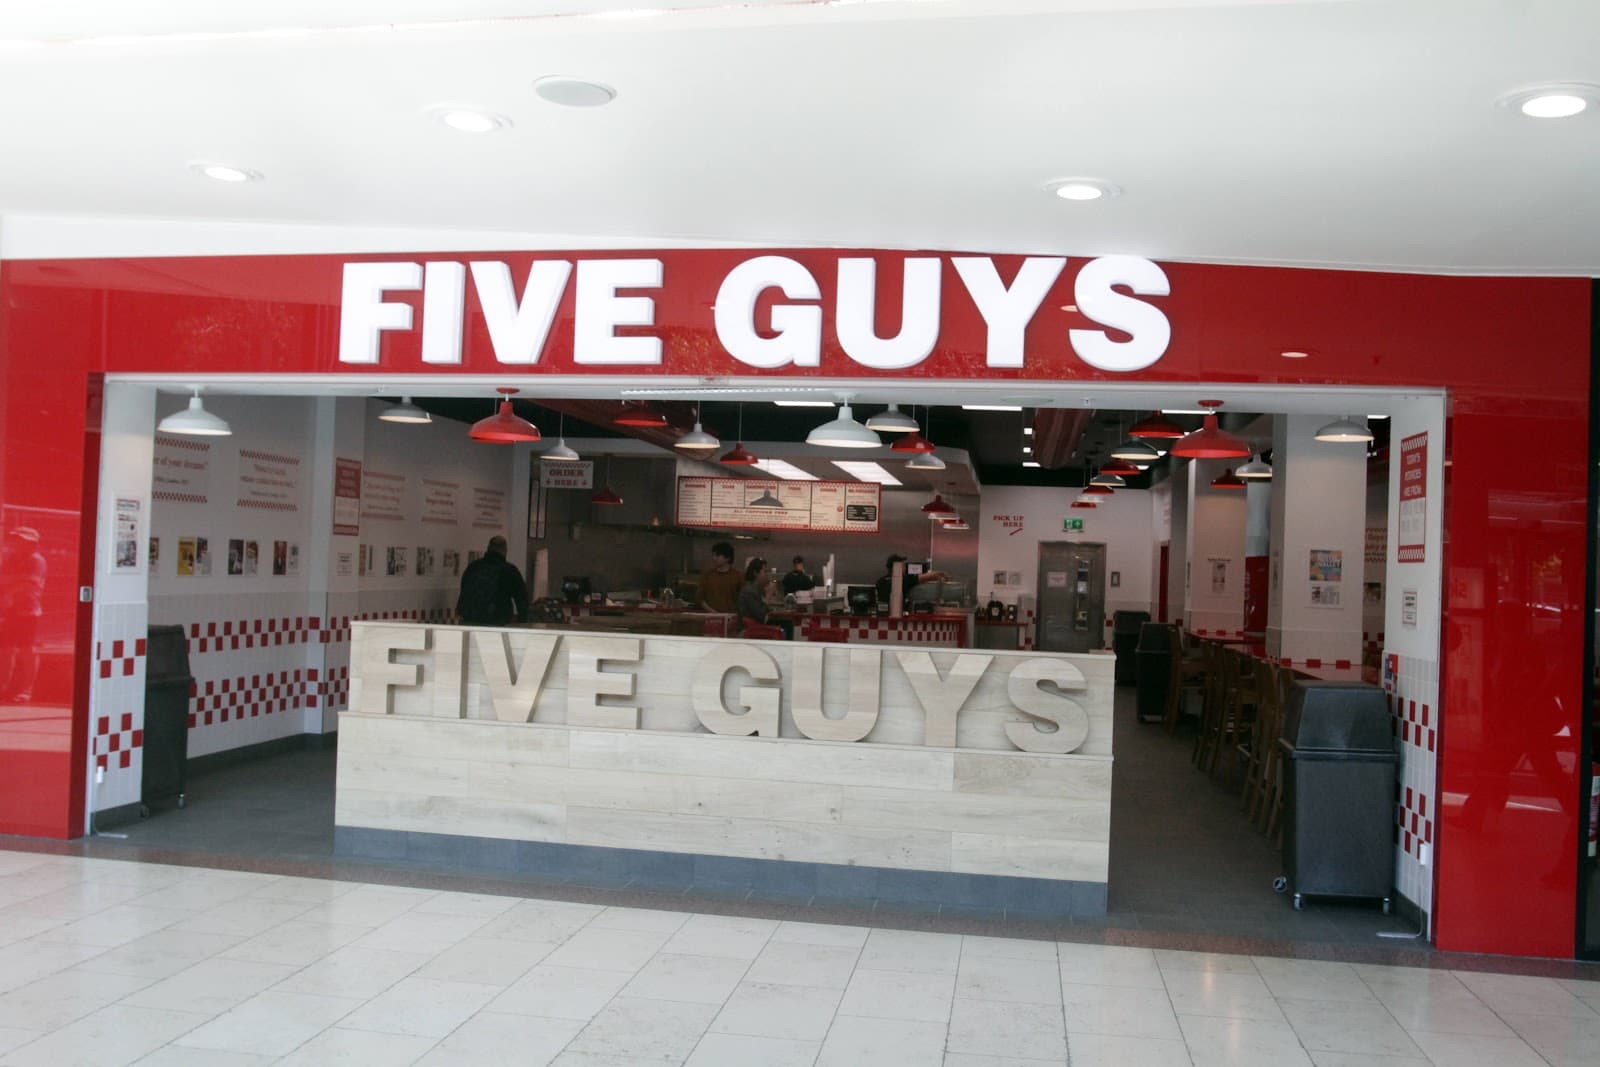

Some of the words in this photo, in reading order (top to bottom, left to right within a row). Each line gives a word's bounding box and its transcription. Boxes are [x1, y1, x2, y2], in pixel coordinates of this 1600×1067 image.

[338, 257, 664, 366] FIVE
[714, 255, 1172, 372] GUYS
[549, 469, 584, 477] ORDER
[361, 627, 645, 730] FIVE
[692, 643, 1089, 754] GUYS
